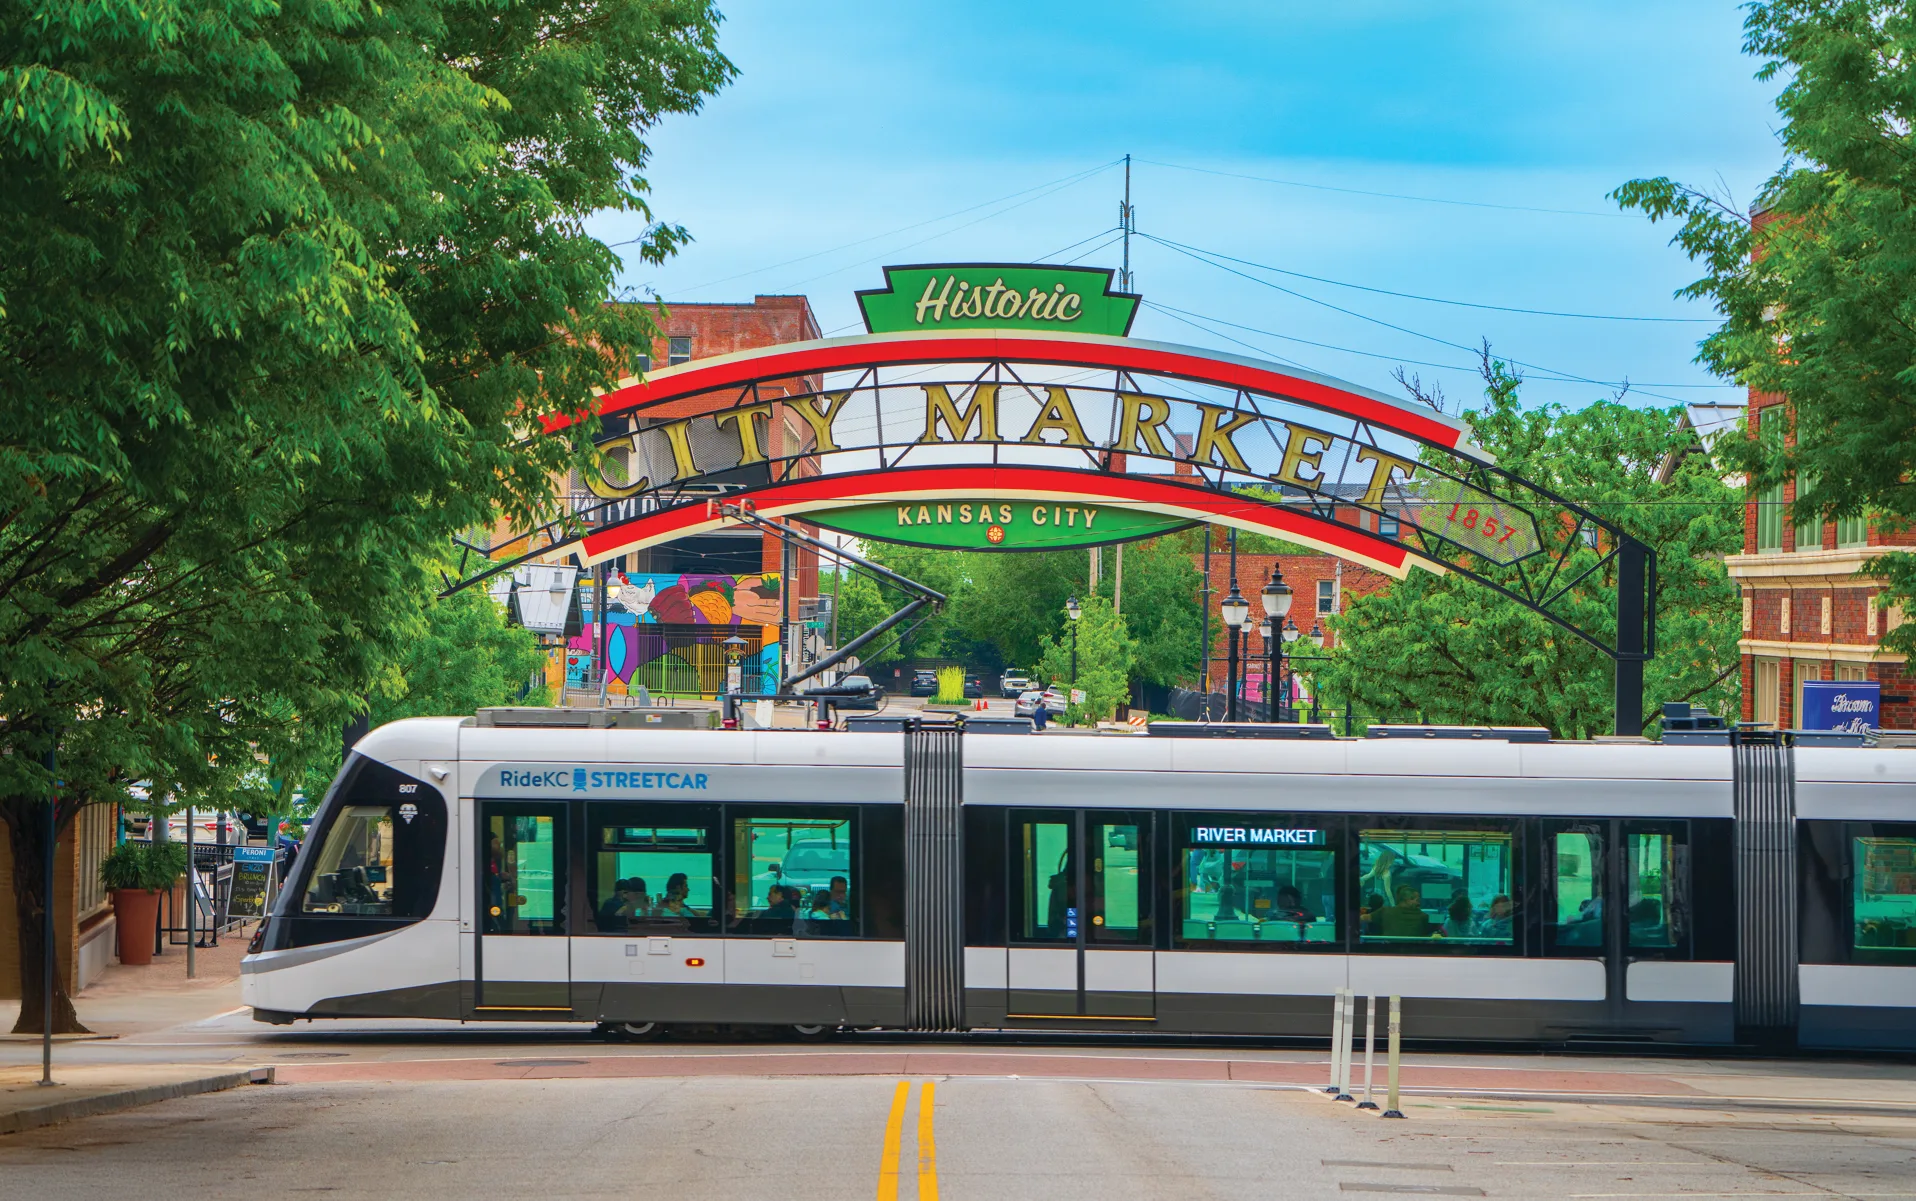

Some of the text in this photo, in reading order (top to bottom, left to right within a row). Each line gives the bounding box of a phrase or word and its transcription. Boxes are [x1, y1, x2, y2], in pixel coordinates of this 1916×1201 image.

[915, 275, 1082, 323] Historic
[584, 383, 1416, 512] CITY MARKET
[897, 504, 1097, 528] KANSAS CITY
[1446, 503, 1516, 543] 1857
[398, 784, 418, 794] 807
[500, 770, 709, 790] RideKC STREETCAR
[1197, 827, 1317, 843] RIVER MARKET
